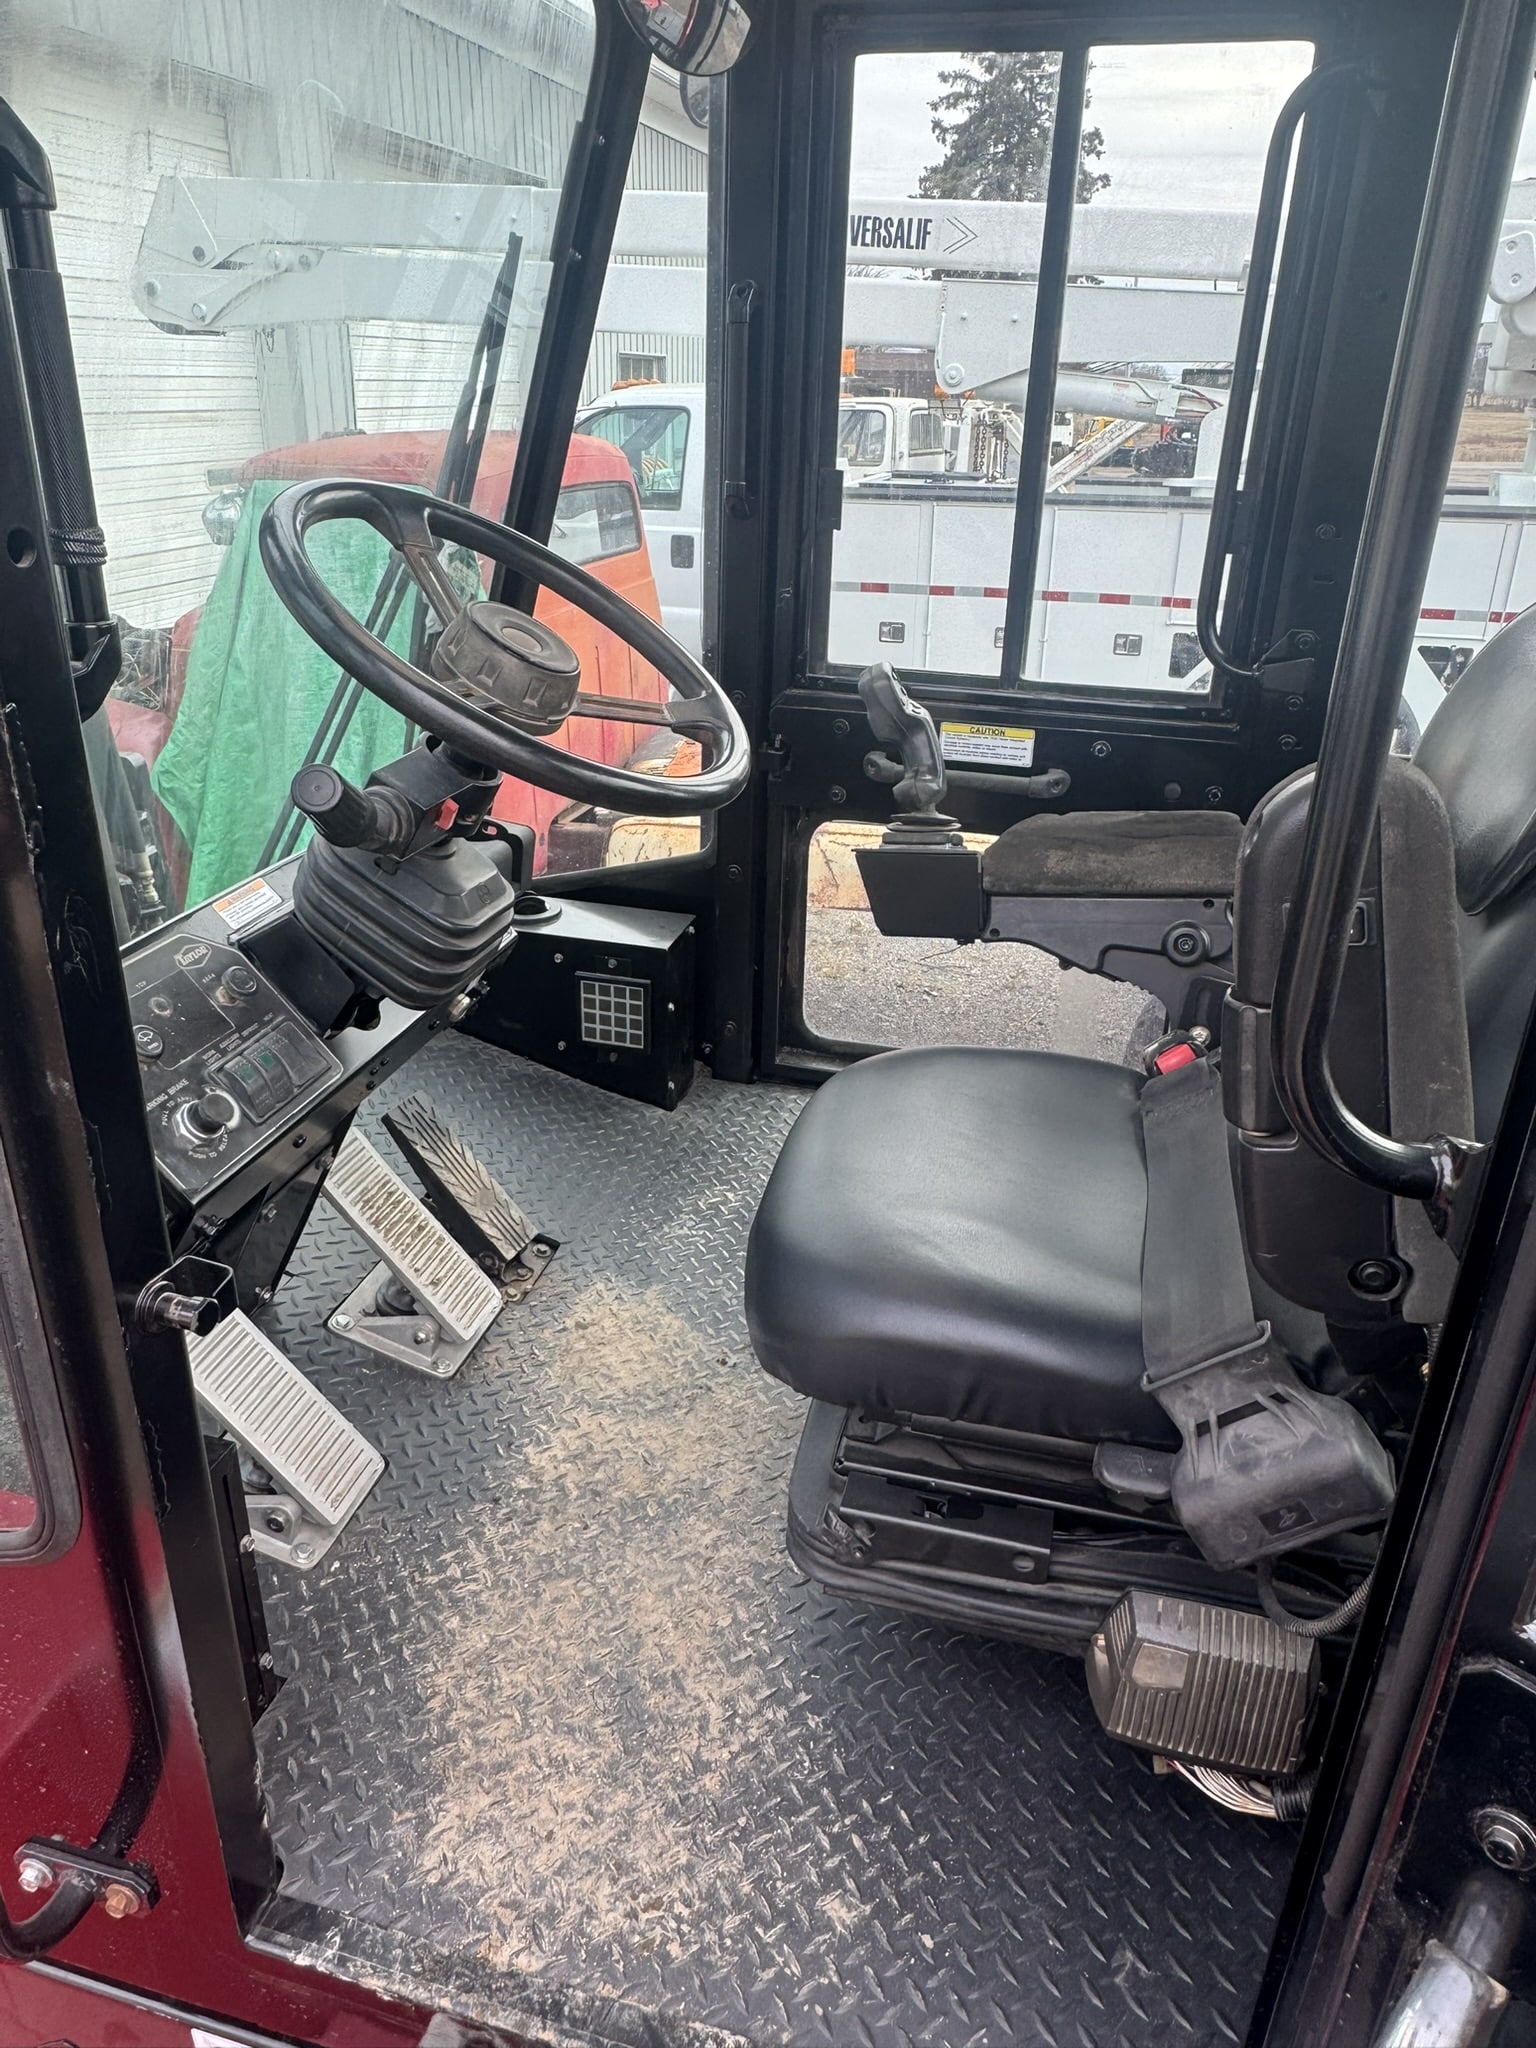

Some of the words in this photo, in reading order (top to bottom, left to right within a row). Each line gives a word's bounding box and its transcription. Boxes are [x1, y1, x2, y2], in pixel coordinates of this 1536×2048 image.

[969, 726, 1006, 736] CAUTION
[174, 945, 209, 966] TAYLOR
[146, 1093, 169, 1112] ARKING
[167, 1078, 190, 1096] BRAKE
[166, 1100, 176, 1108] TO
